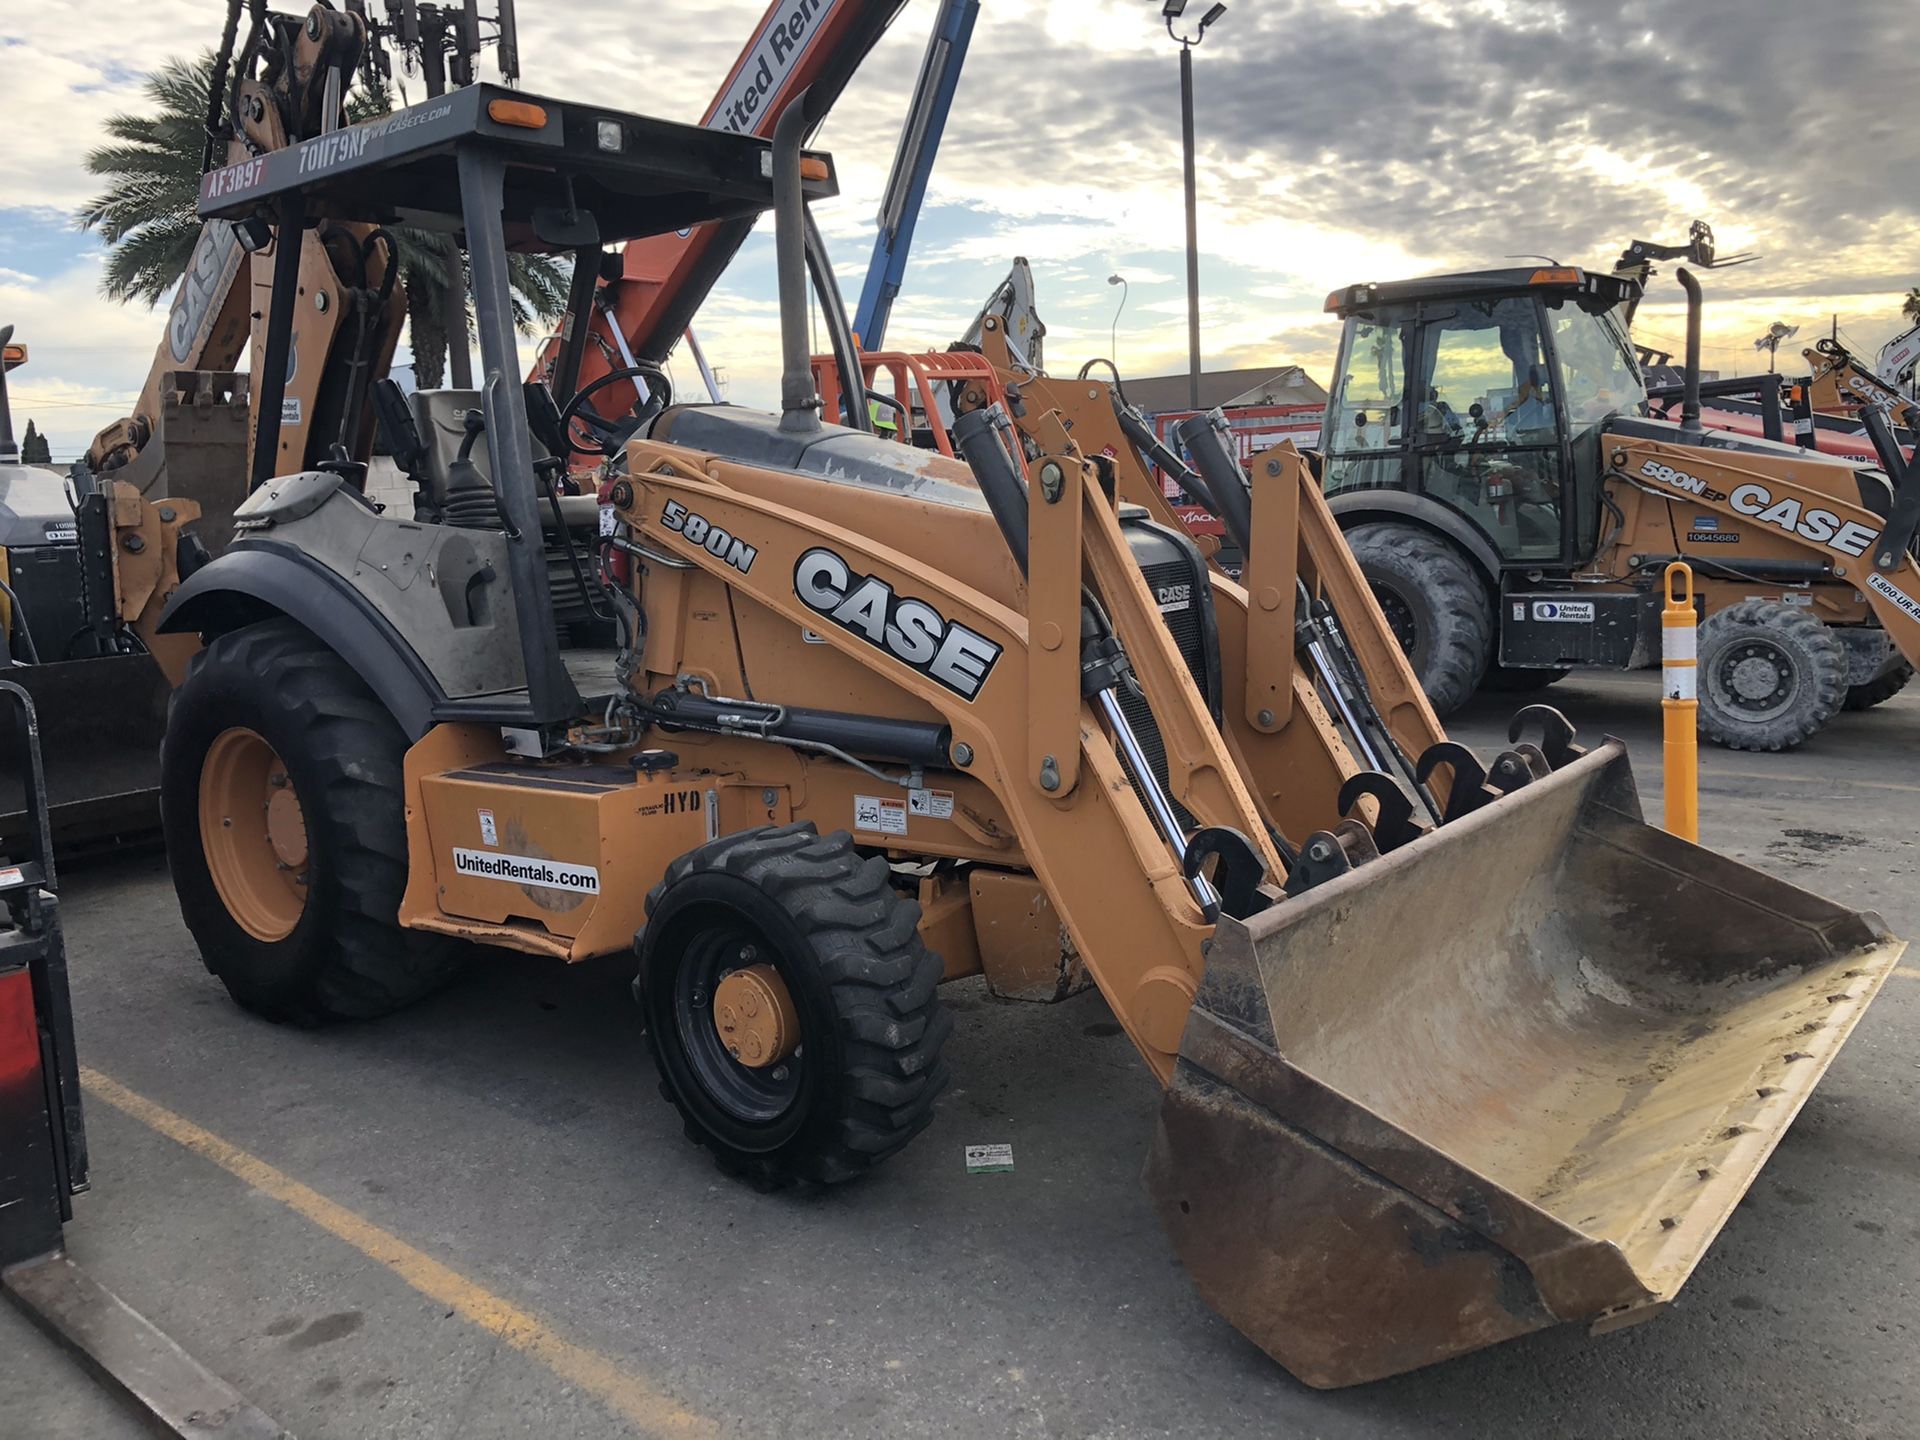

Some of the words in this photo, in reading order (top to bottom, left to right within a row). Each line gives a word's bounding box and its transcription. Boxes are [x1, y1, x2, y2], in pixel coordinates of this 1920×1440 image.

[723, 54, 774, 132] ited
[768, 0, 820, 66] Ren
[282, 402, 298, 411] nited
[282, 412, 300, 421] entals
[1641, 460, 1708, 496] 580N
[1701, 488, 1727, 502] EP
[1178, 511, 1217, 524] YJACK
[1729, 483, 1880, 558] CASE
[661, 500, 758, 574] 580N
[1159, 585, 1190, 603] CASE
[1560, 604, 1588, 612] United
[1871, 577, 1920, 619] 1-800-UR-R
[794, 547, 1003, 702] CASE
[663, 790, 700, 815] HYD
[456, 852, 597, 889] UnitedRentals.com
